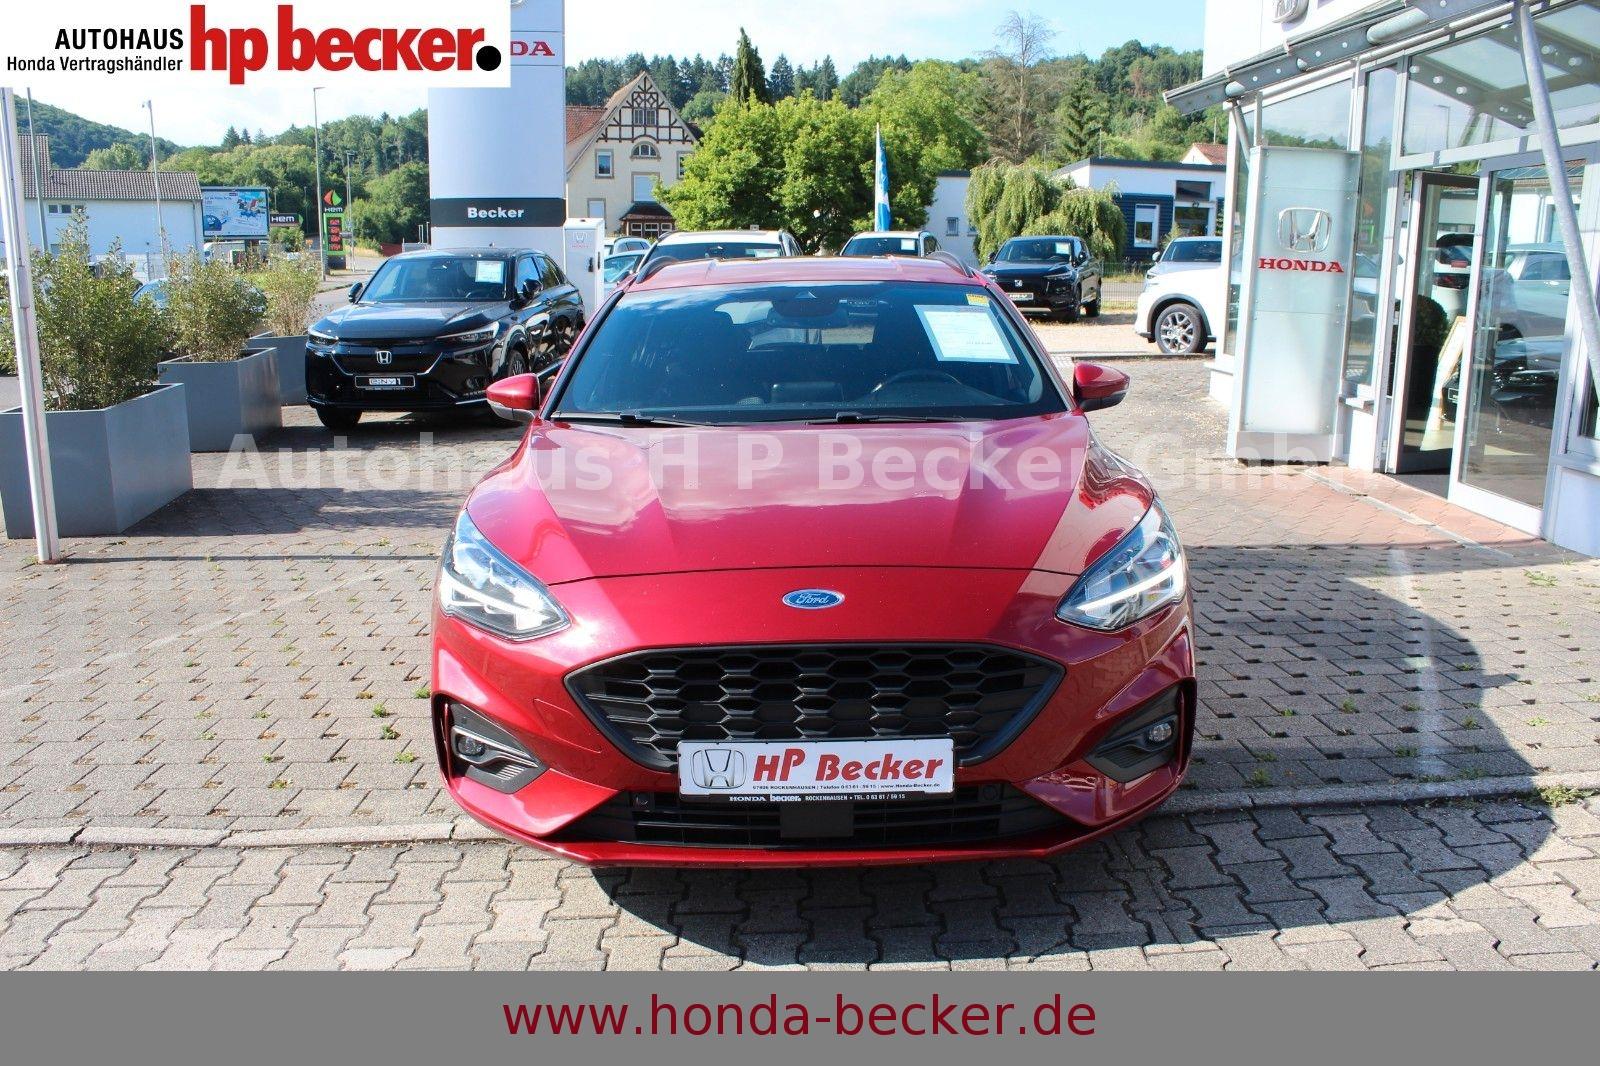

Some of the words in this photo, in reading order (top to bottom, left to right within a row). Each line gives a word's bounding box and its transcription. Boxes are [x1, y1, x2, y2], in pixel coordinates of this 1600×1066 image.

[467, 206, 525, 219] Becker
[1258, 258, 1344, 273] HONDA
[795, 592, 830, 604] Ford
[753, 748, 806, 782] HP
[815, 753, 944, 781] Becker
